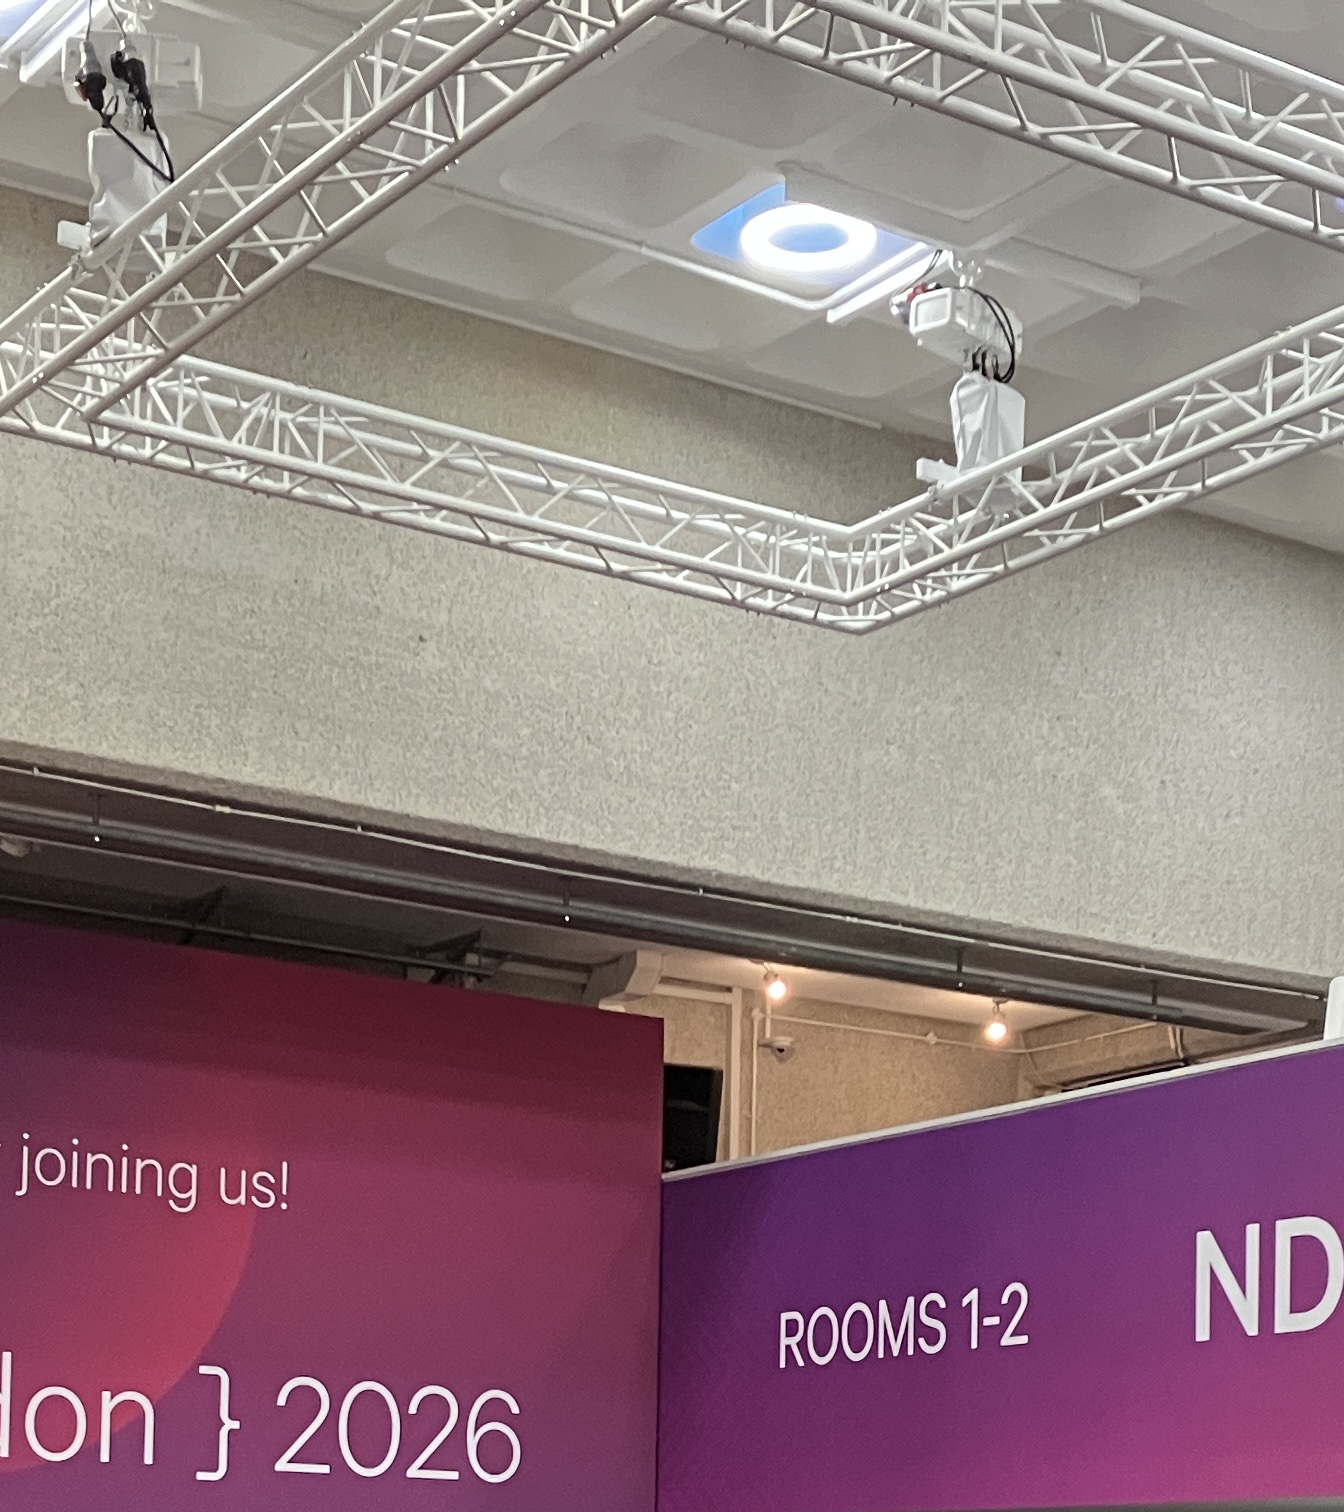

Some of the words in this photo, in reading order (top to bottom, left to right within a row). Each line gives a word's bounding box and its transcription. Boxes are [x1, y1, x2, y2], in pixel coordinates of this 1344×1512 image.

[16, 1133, 197, 1212] joining
[220, 1162, 287, 1209] us!
[779, 1293, 946, 1368] ROOMS
[962, 1283, 1028, 1349] 1-2
[196, 1366, 240, 1480] }
[275, 1377, 520, 1483] 2026
